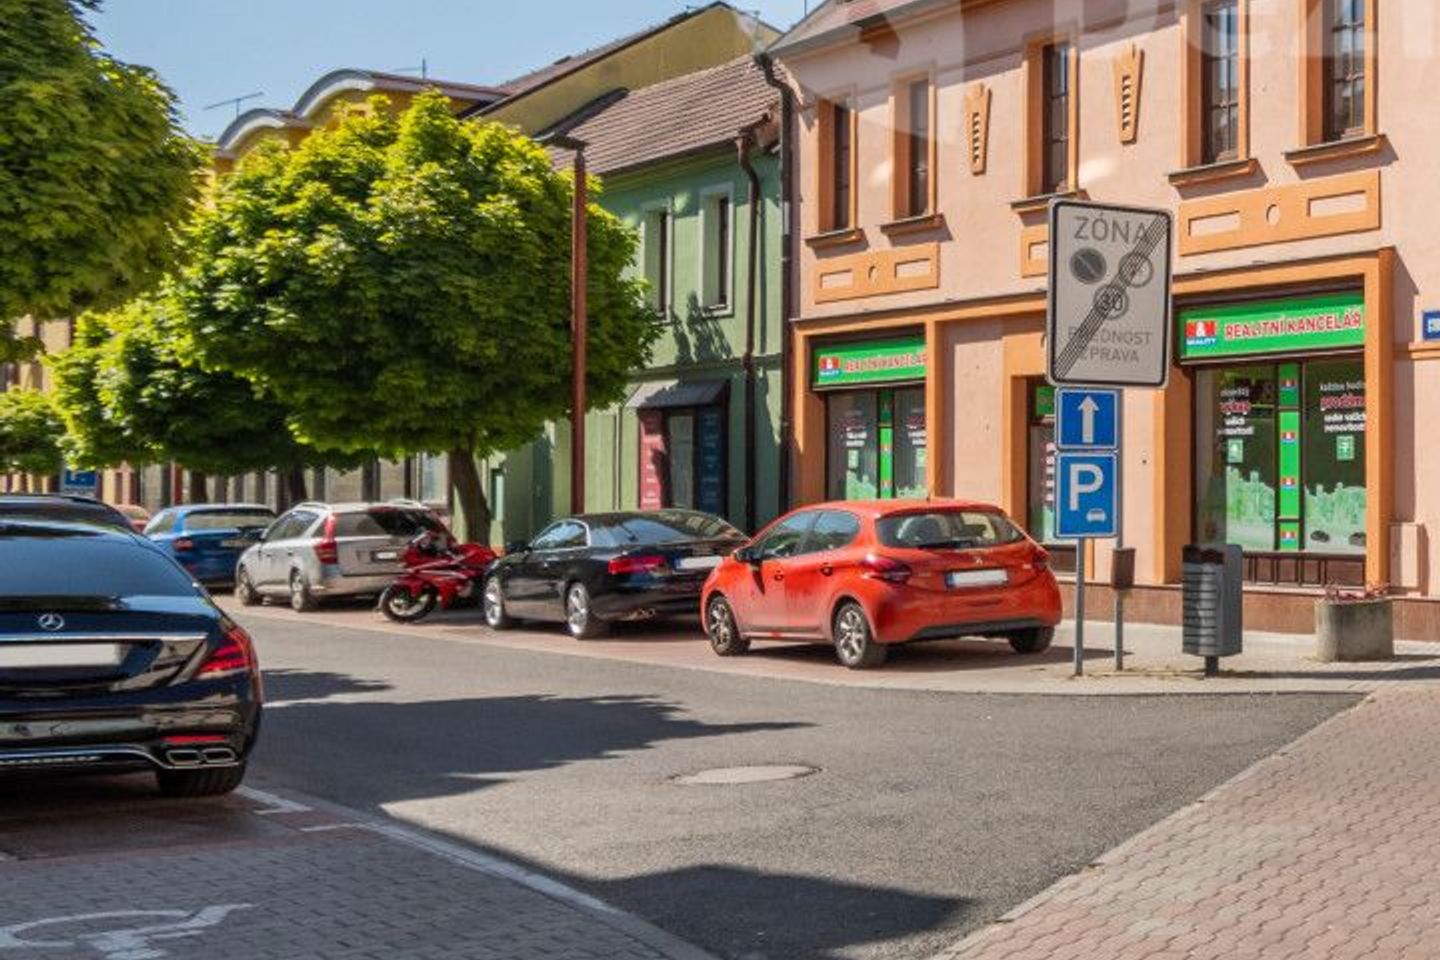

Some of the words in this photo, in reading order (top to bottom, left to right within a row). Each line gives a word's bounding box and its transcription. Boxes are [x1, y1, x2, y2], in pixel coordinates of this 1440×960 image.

[1069, 325, 1152, 346] PEDNOST
[1224, 314, 1285, 340] REALITNÍ
[1069, 463, 1104, 511] P
